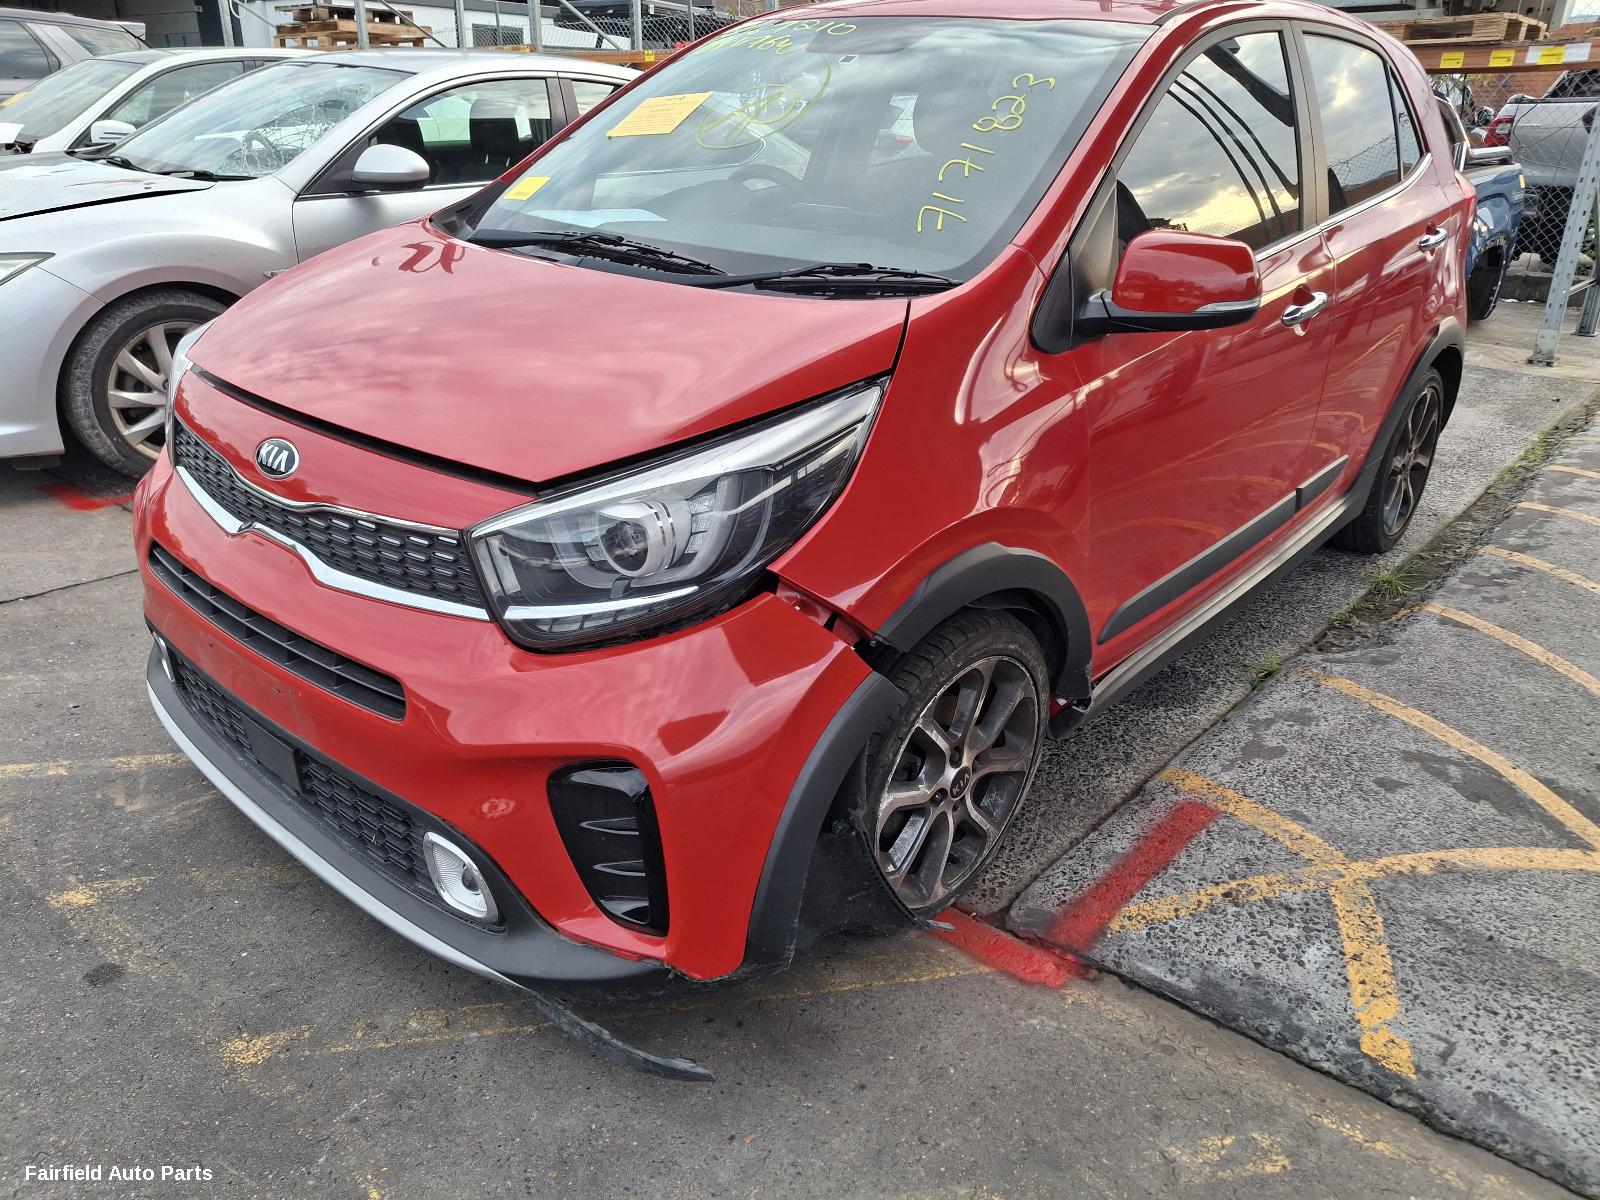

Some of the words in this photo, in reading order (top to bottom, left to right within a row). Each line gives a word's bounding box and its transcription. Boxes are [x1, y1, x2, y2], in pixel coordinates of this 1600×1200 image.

[916, 72, 1056, 232] 7171823
[257, 442, 289, 473] KIA
[951, 773, 970, 796] KIA
